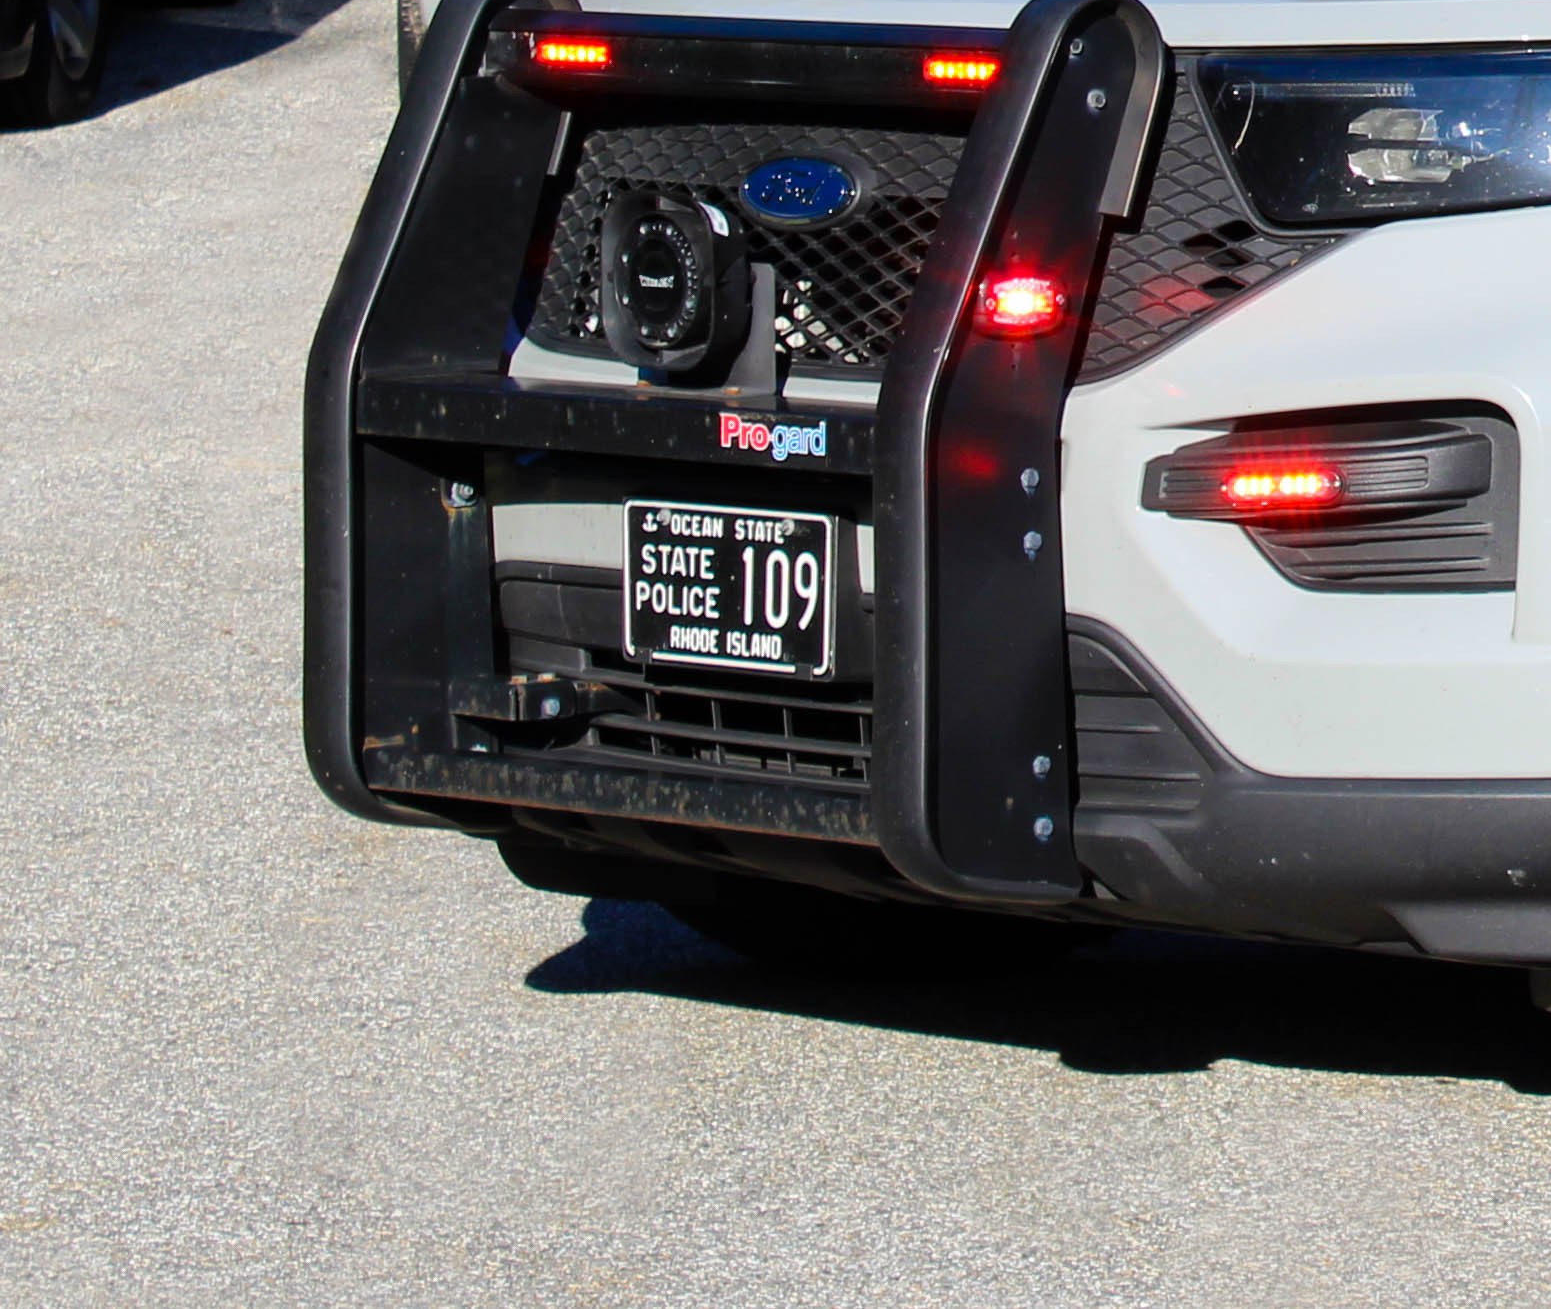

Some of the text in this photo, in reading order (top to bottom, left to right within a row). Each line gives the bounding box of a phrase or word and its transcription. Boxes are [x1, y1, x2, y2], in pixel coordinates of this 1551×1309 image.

[669, 513, 785, 544] OCEAN STATE
[641, 543, 715, 580] STATE
[635, 580, 720, 619] POLICE
[741, 546, 819, 631] 109
[669, 625, 782, 660] RHODE ISLAND
